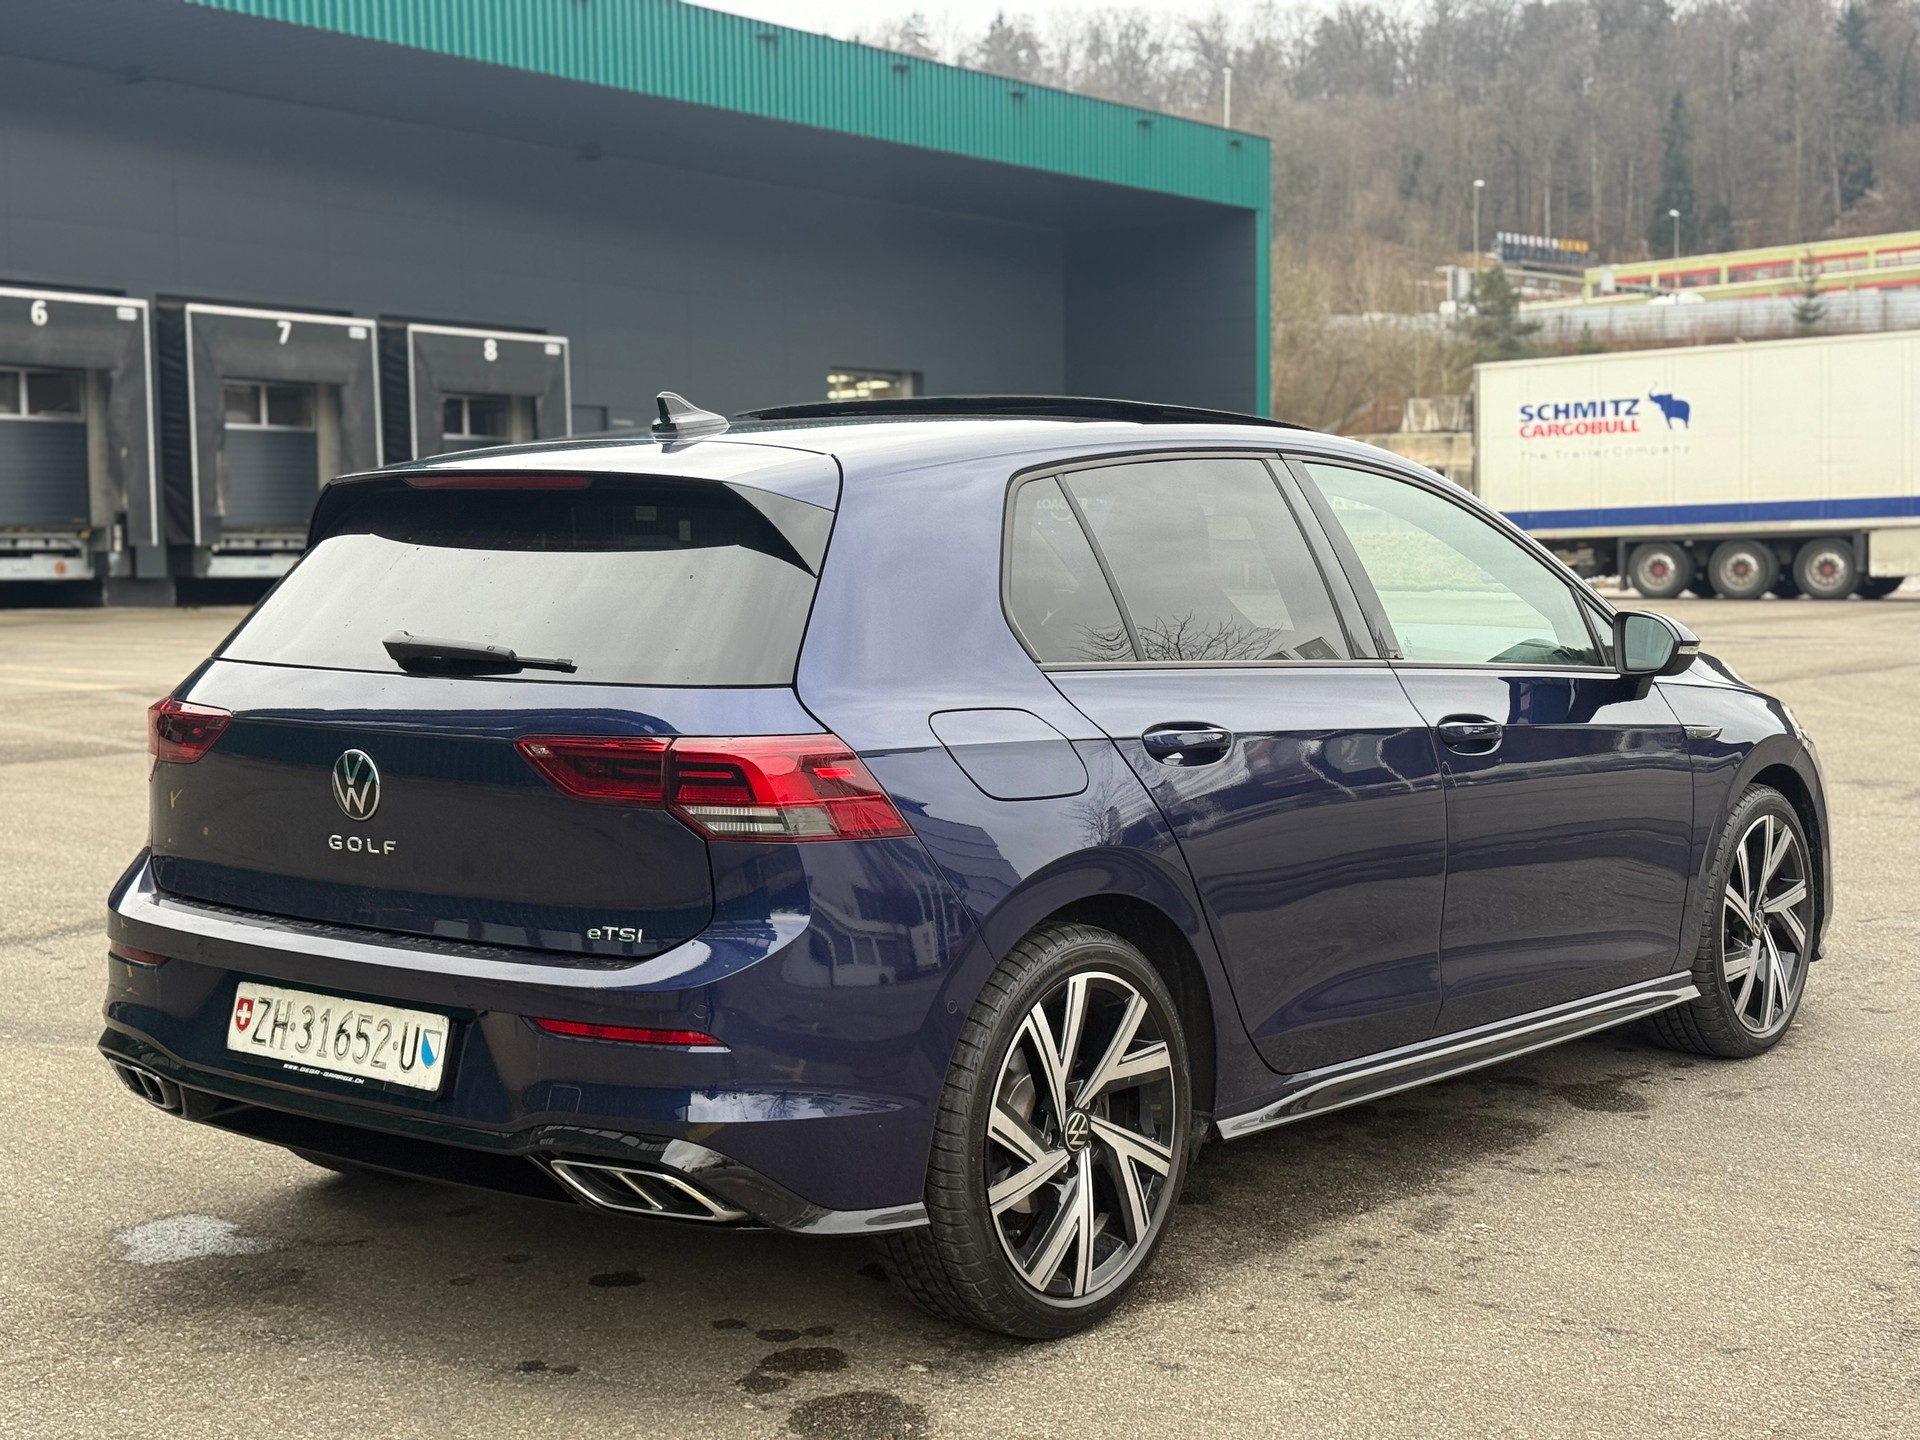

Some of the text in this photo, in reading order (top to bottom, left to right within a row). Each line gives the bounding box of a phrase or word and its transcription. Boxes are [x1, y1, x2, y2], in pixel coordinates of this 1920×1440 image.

[31, 300, 48, 326] 6
[277, 320, 291, 344] 7
[484, 338, 498, 361] 8
[1520, 398, 1640, 422] SCHMITZ
[1520, 419, 1640, 439] CARGOBULL
[332, 750, 380, 820] VW
[329, 835, 397, 855] GOLF
[587, 926, 643, 943] eTSI
